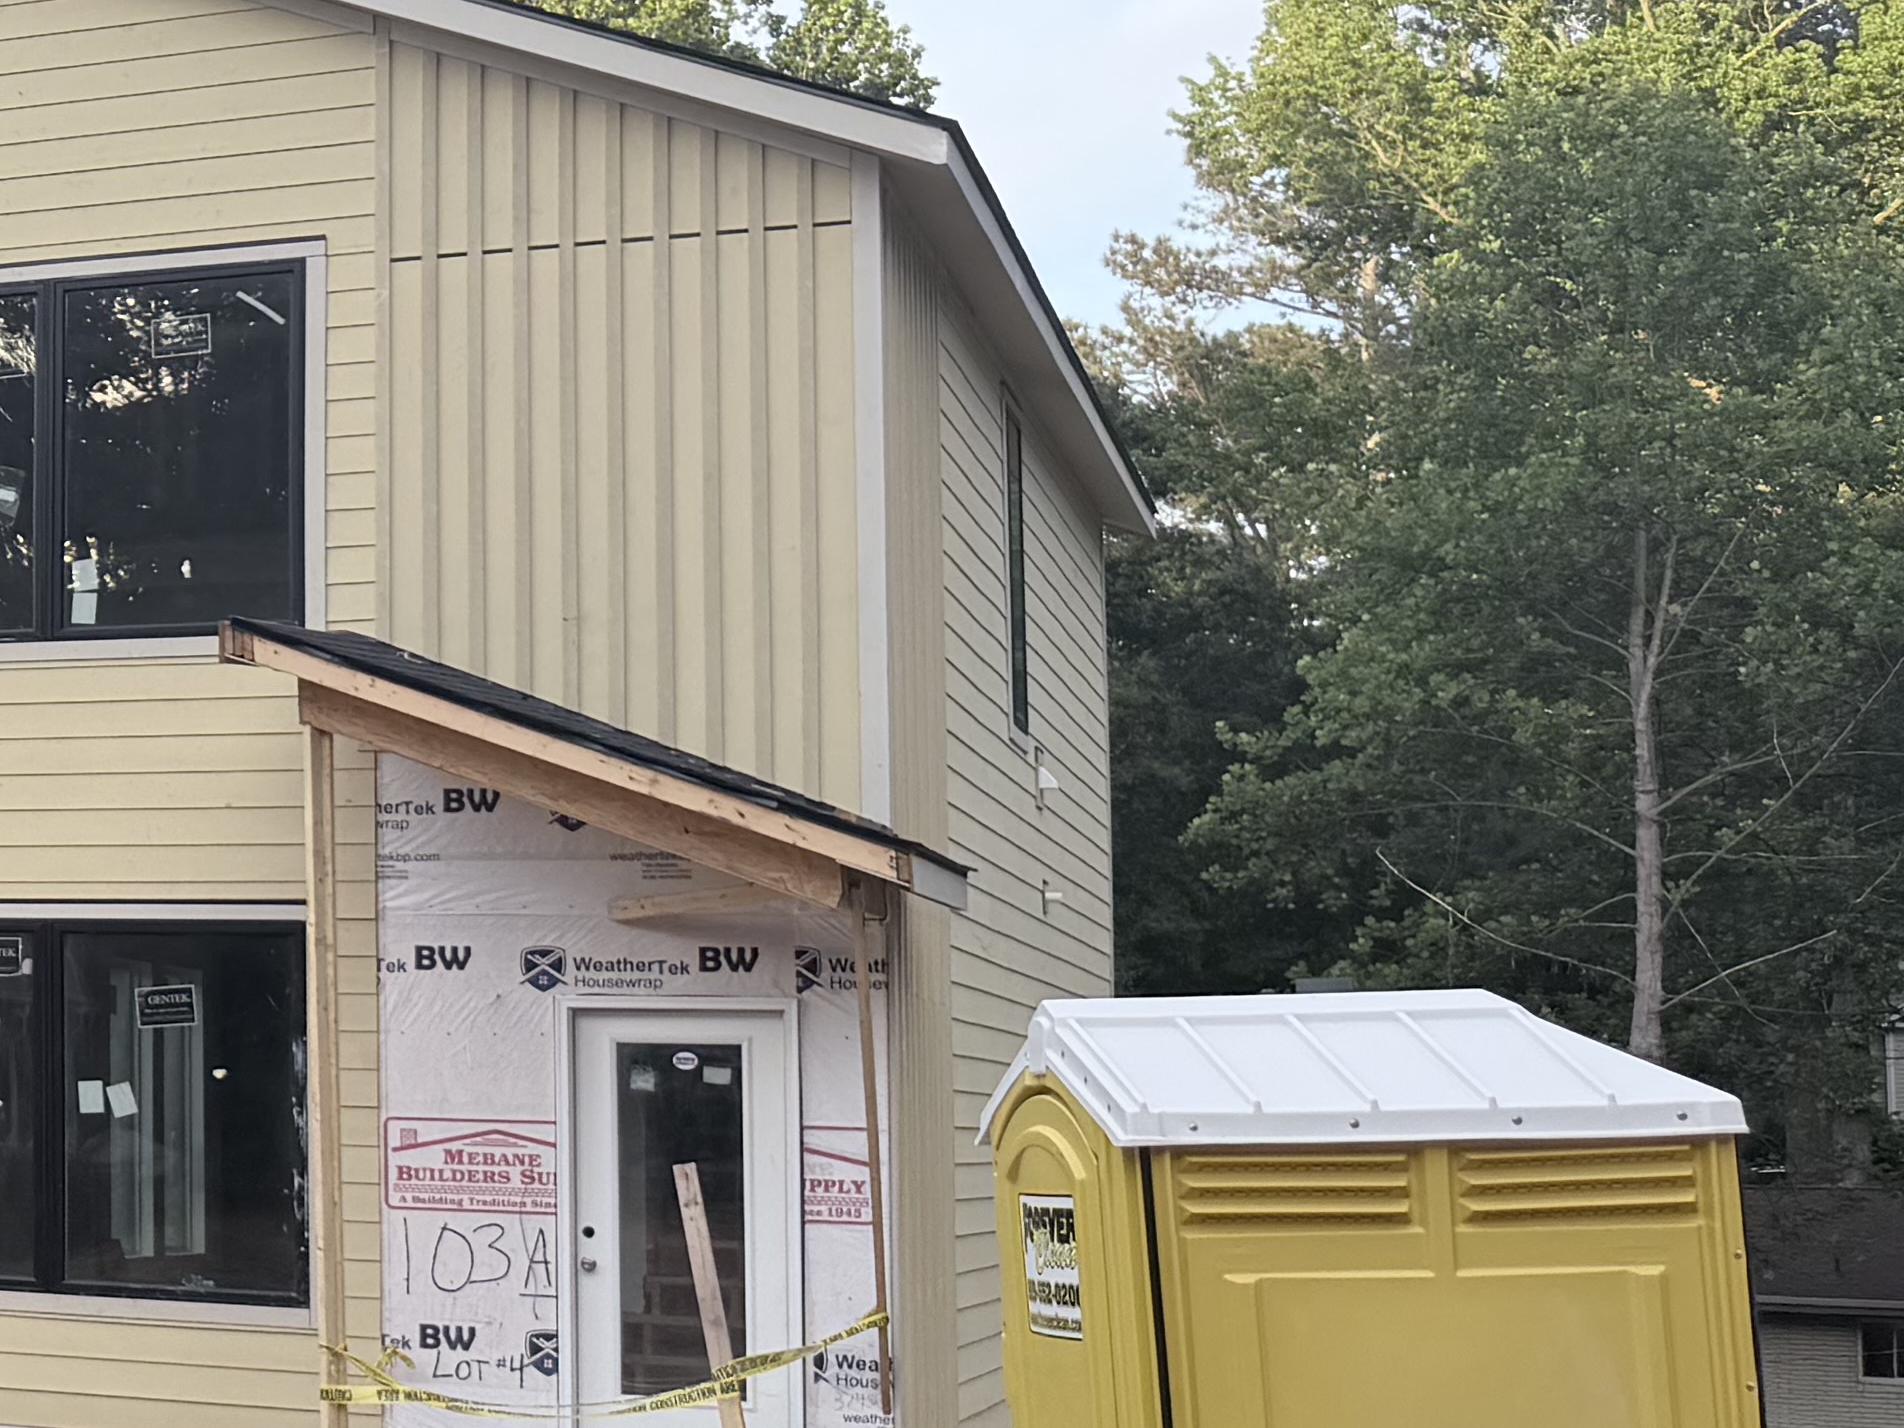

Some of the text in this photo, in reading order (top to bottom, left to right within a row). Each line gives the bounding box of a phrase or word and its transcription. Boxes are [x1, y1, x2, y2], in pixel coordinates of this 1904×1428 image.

[443, 787, 500, 813] BW
[414, 944, 472, 971] BW
[573, 945, 760, 976] WeatherTek BW
[574, 975, 664, 990] Housewrap
[442, 1148, 542, 1168] MEBANE
[395, 1164, 512, 1186] BUILDERS
[805, 1177, 867, 1195] PPLY
[398, 1194, 408, 1204] A
[411, 1194, 464, 1209] Building
[468, 1196, 527, 1209] Tradition
[827, 1206, 863, 1220] 1945
[419, 1323, 477, 1351] BW
[432, 1350, 490, 1382] LOT
[649, 1385, 717, 1411] CONSTRUCTION
